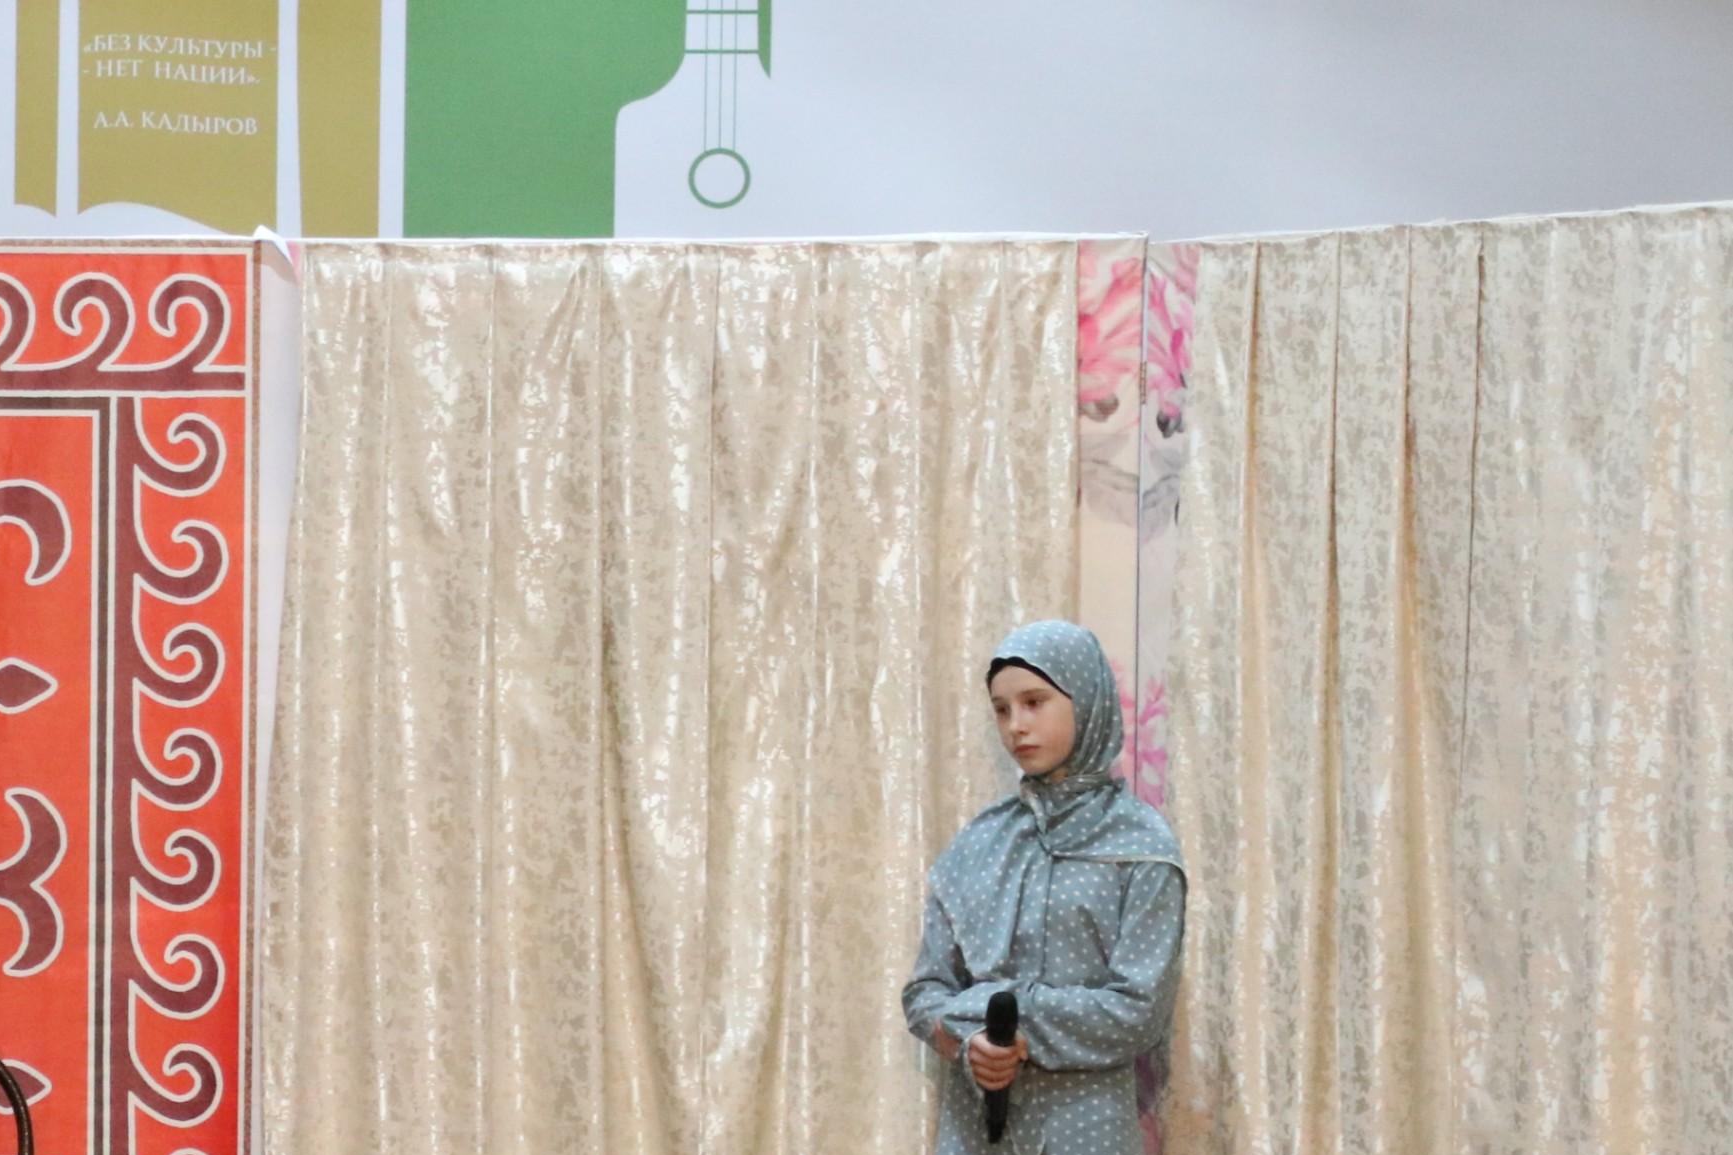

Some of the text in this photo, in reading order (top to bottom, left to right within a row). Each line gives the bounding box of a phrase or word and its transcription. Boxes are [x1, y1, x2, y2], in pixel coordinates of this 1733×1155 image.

[138, 35, 263, 59] КУЛЬТУРЫ
[96, 60, 142, 77] НЕТ
[141, 112, 258, 136] КАДЫРОВ
